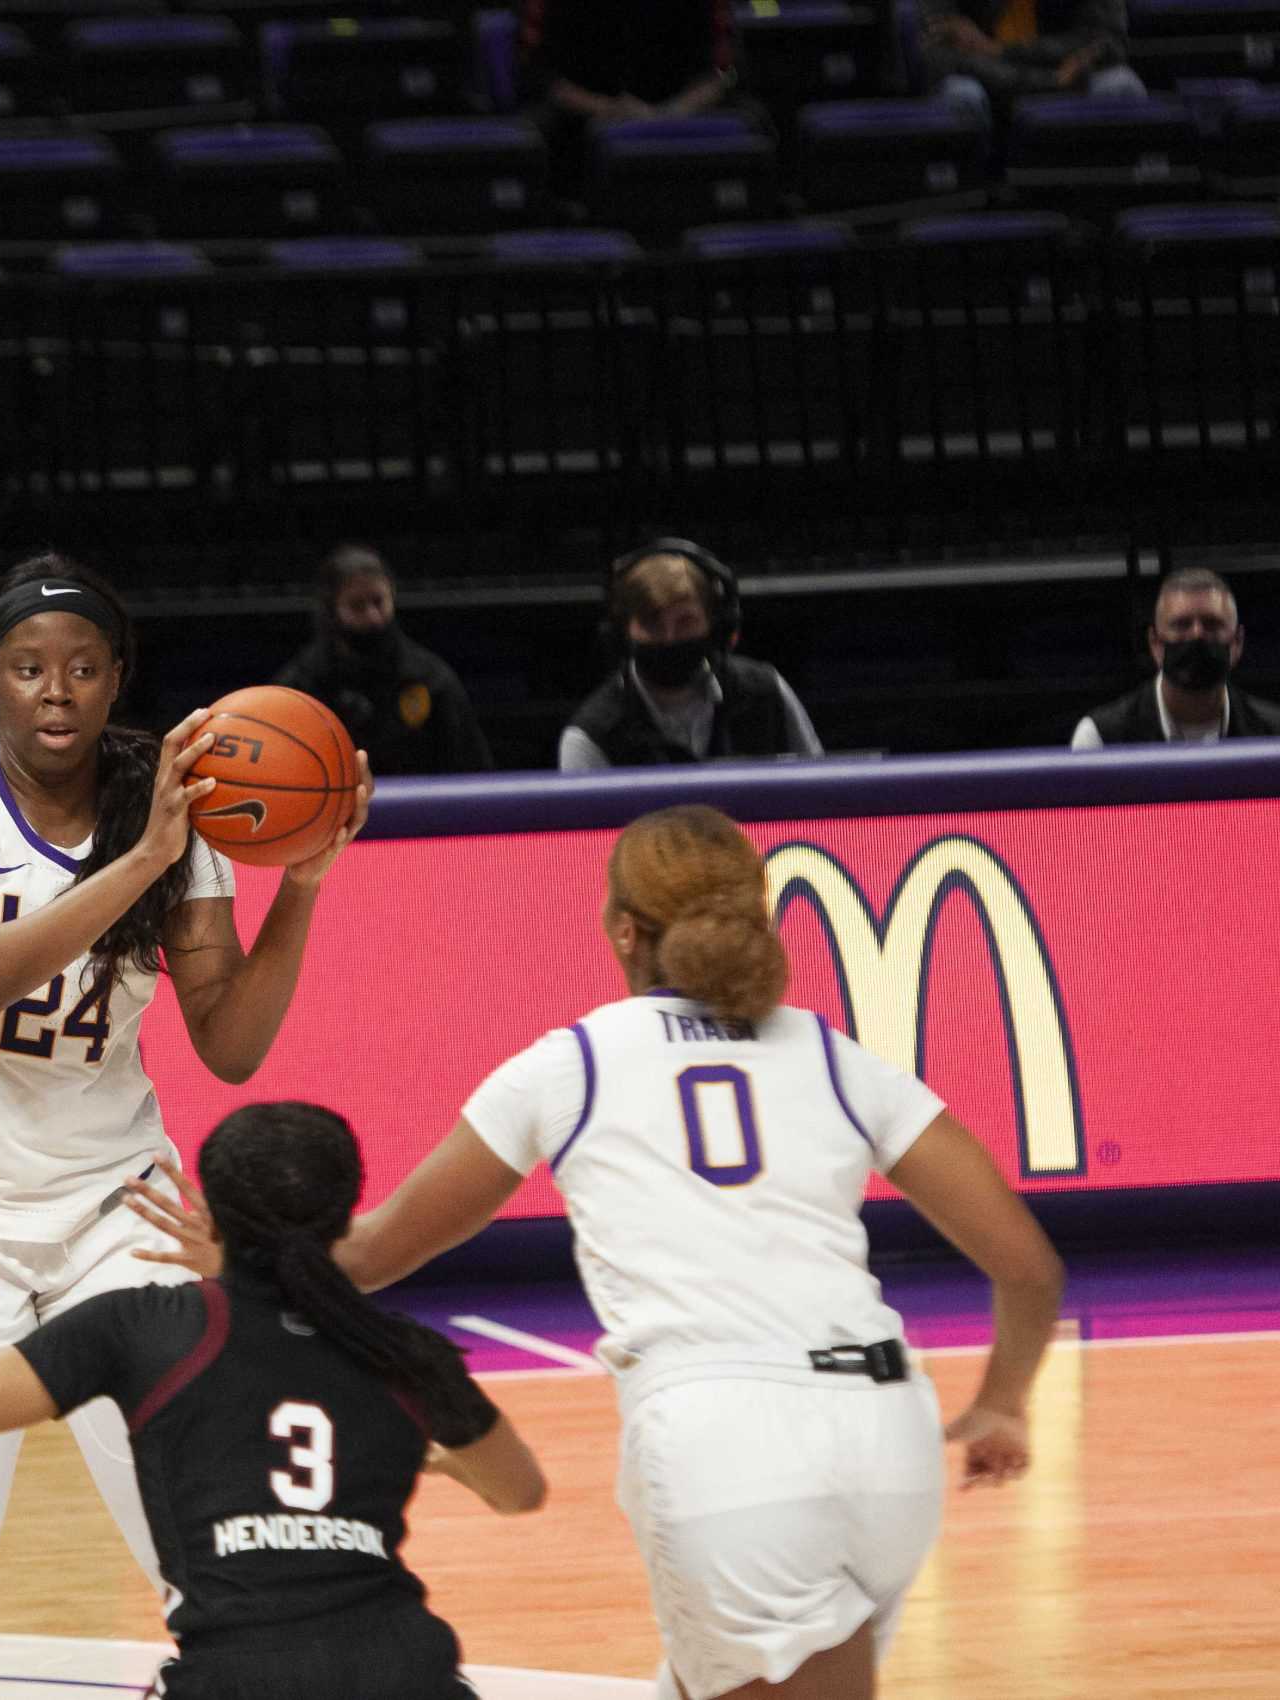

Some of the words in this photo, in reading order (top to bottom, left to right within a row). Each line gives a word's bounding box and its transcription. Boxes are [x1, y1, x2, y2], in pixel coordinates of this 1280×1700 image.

[675, 1063, 763, 1188] 0
[269, 1401, 334, 1511] 3
[213, 1514, 389, 1560] HENDERSON
